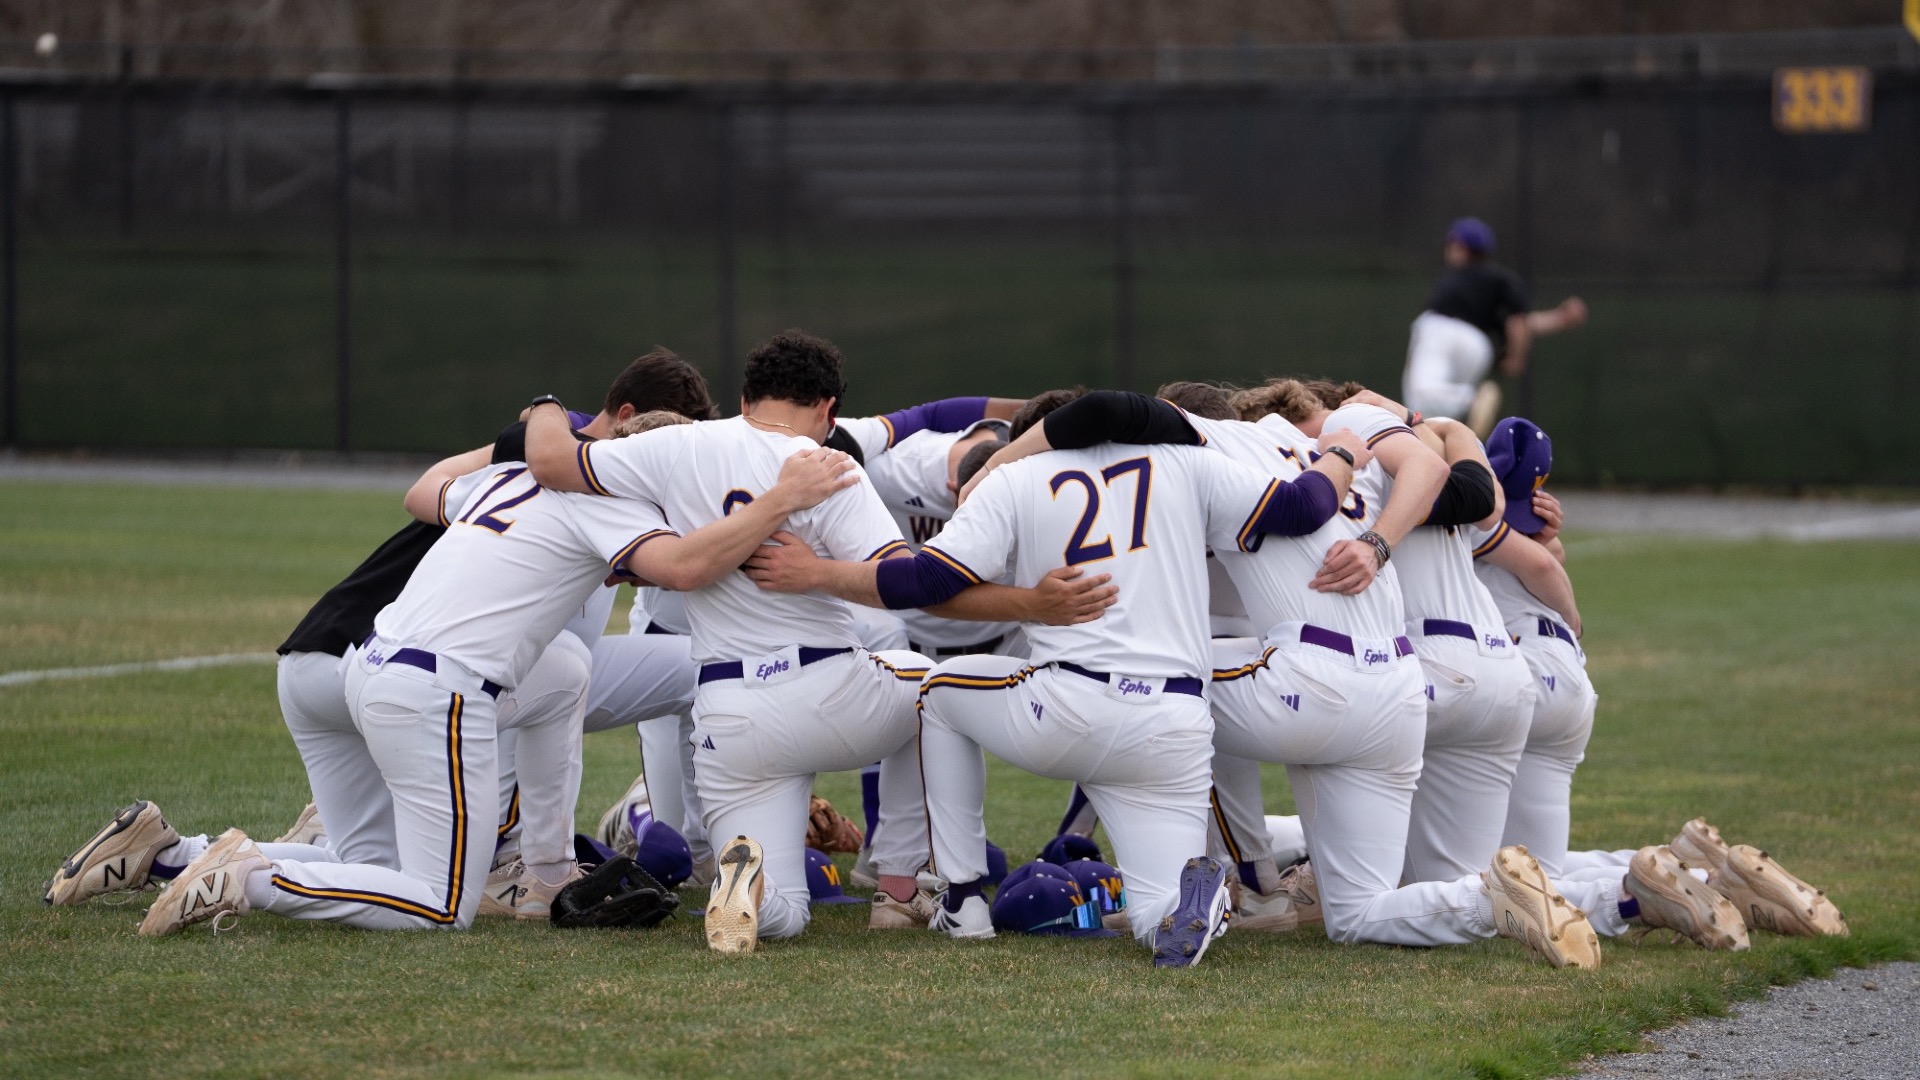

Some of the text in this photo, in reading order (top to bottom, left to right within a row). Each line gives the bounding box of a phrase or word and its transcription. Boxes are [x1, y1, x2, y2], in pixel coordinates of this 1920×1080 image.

[1782, 69, 1859, 129] 333
[457, 467, 543, 536] 12
[1048, 456, 1154, 567] 27
[756, 660, 790, 681] Ephs
[1364, 649, 1389, 666] Ephs
[1118, 677, 1152, 696] Ephs
[104, 857, 126, 888] N
[181, 871, 231, 920] N
[1098, 877, 1123, 900] W
